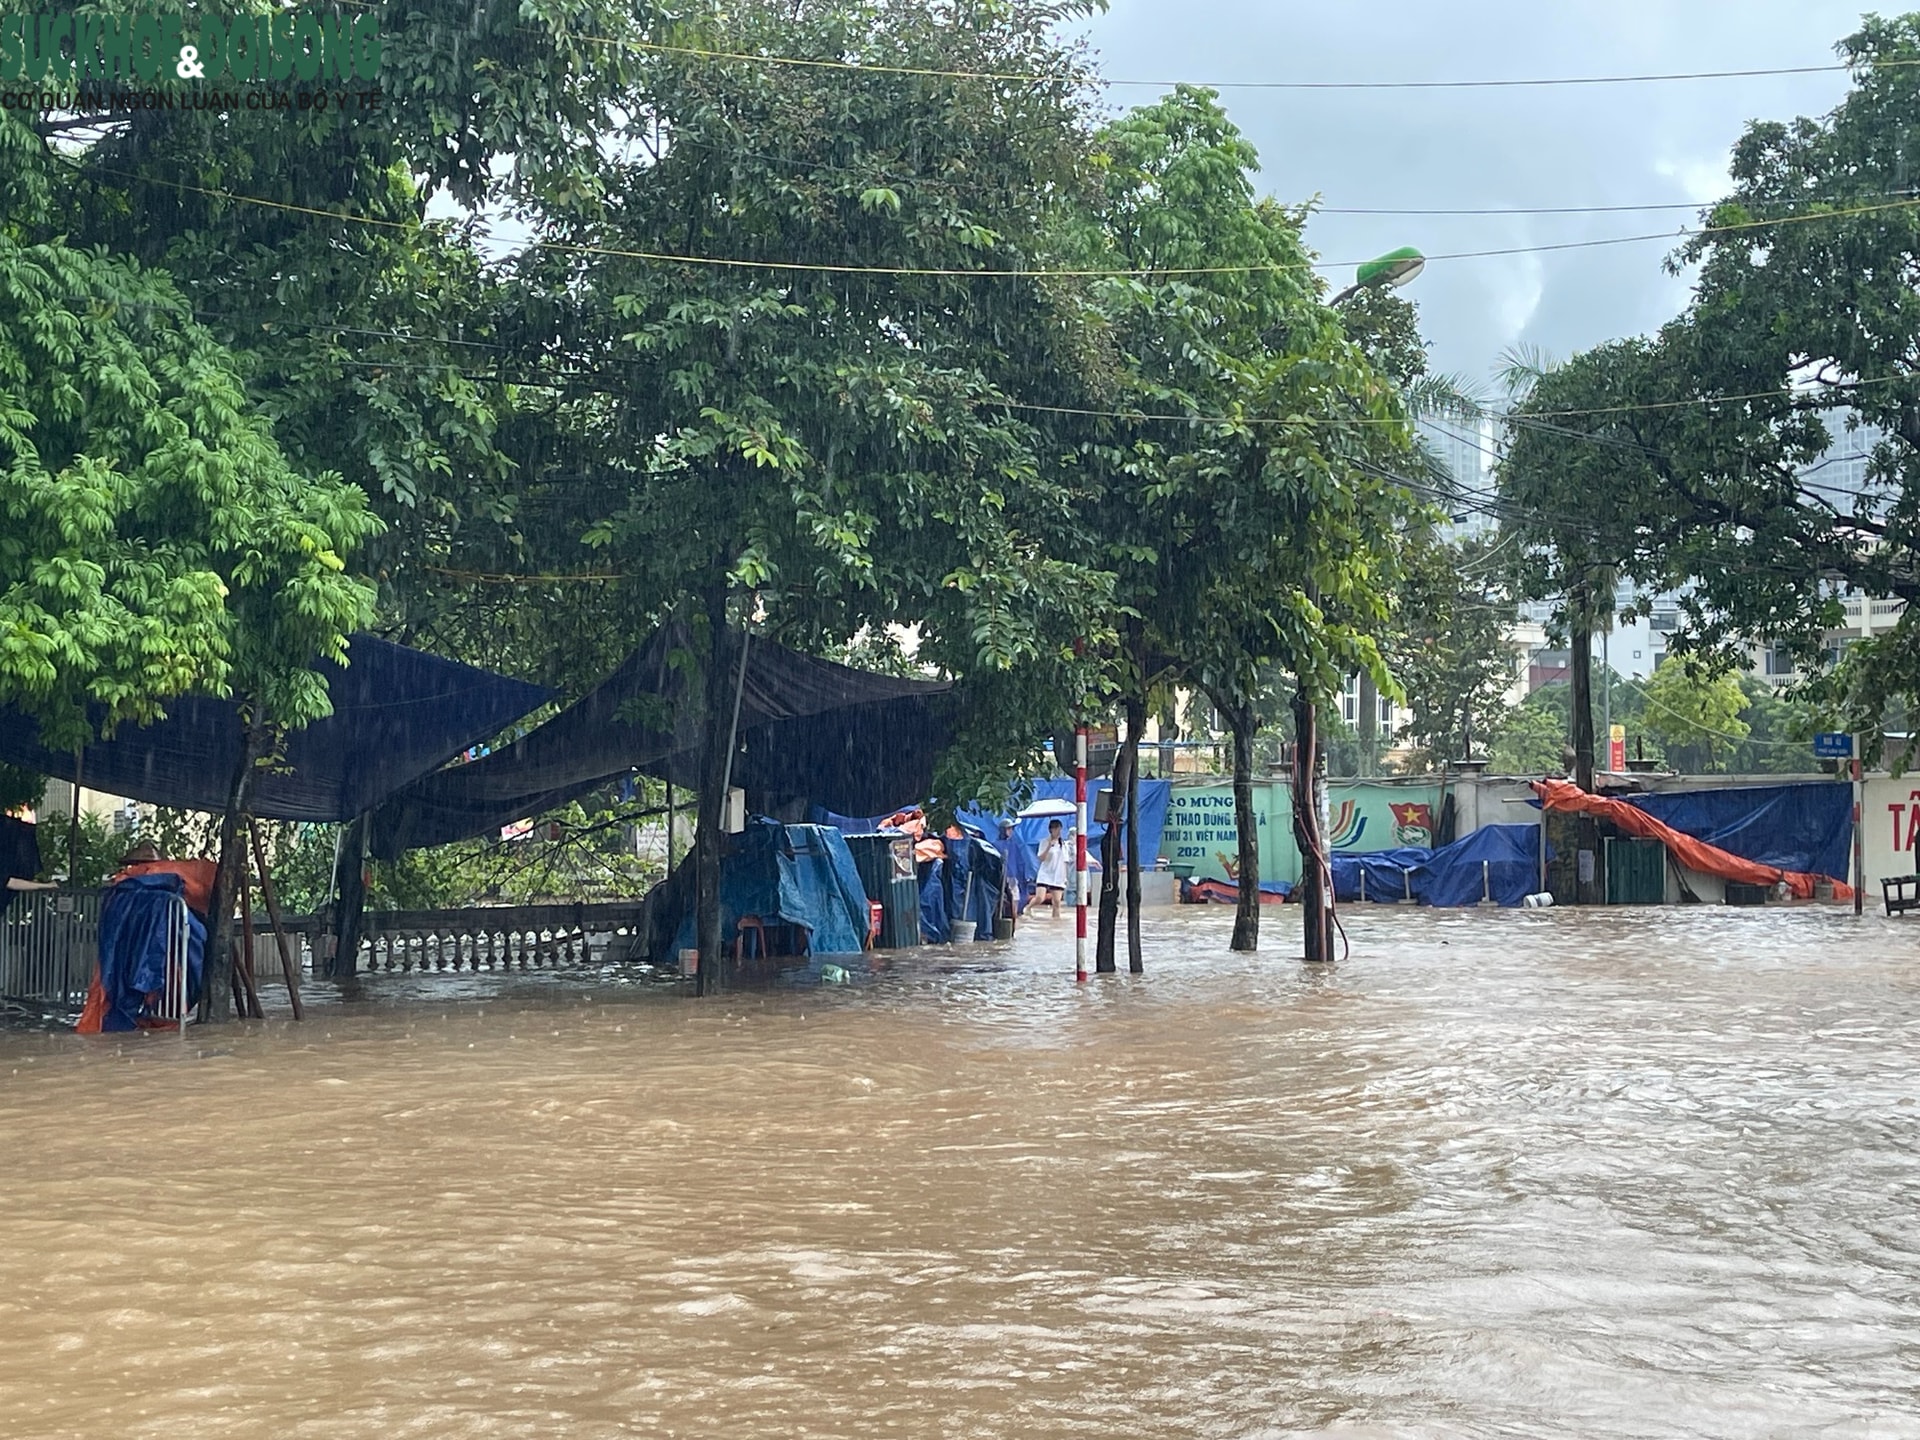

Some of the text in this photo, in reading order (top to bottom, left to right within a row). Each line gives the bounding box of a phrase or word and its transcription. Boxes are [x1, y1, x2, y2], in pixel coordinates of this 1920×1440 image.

[1176, 812, 1201, 826] THAO
[1183, 831, 1193, 841] 31
[1216, 831, 1237, 841] NAM
[1177, 846, 1206, 857] 2021
